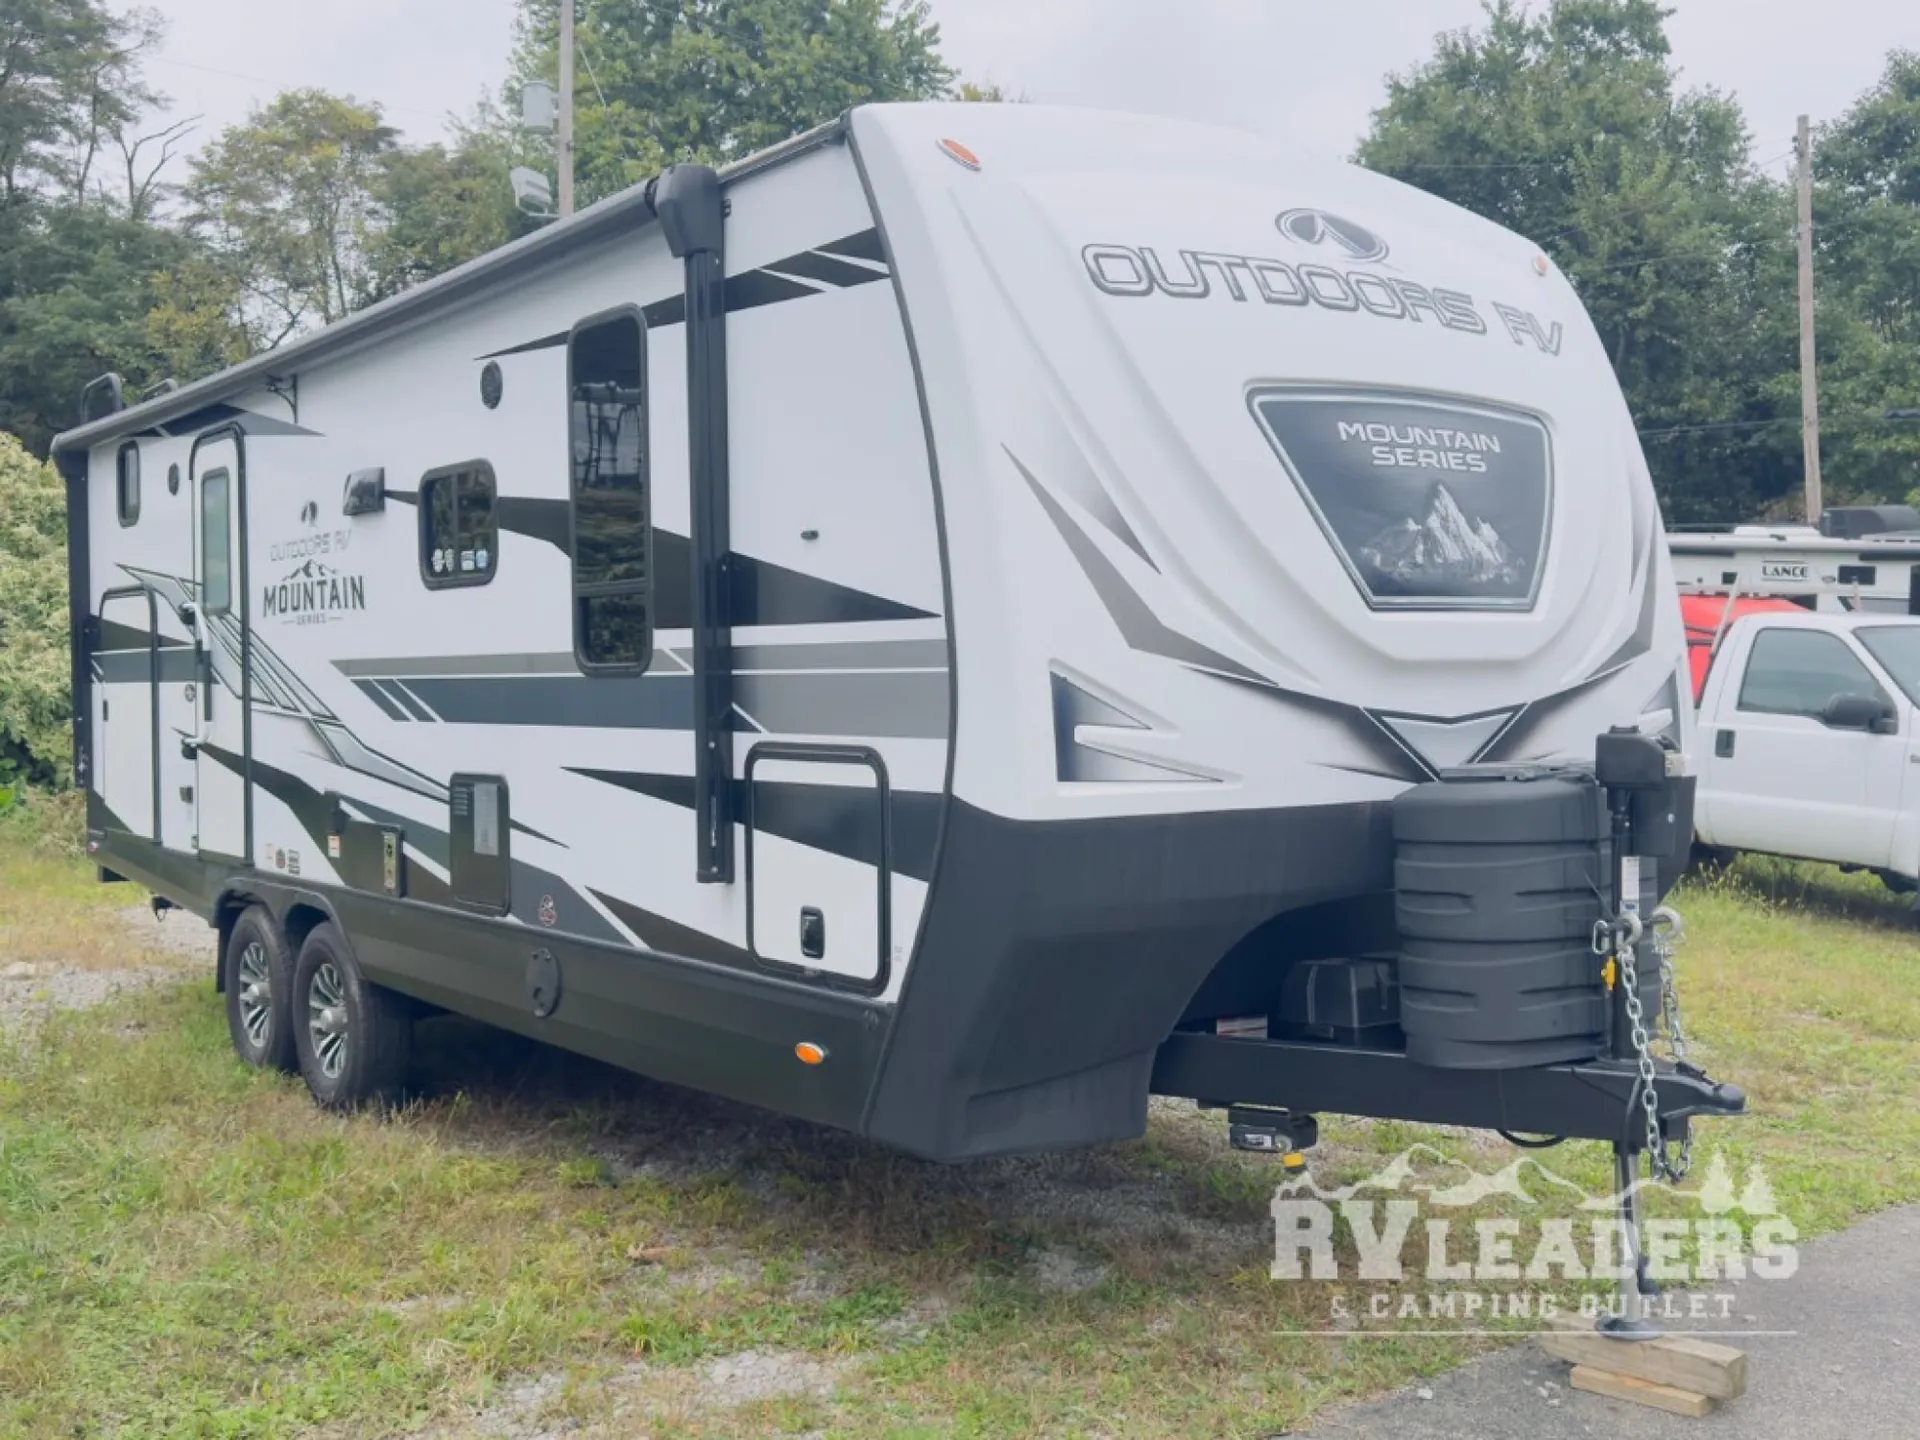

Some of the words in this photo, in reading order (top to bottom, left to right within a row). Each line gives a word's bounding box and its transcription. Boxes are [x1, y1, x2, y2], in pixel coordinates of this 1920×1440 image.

[1082, 244, 1487, 334] OUTDOORS
[1494, 301, 1563, 357] RV
[1337, 420, 1501, 454] MOUNTAIN
[1372, 445, 1487, 473] SERIES
[1762, 563, 1809, 578] LANCE
[263, 575, 366, 618] MOUNTAIN
